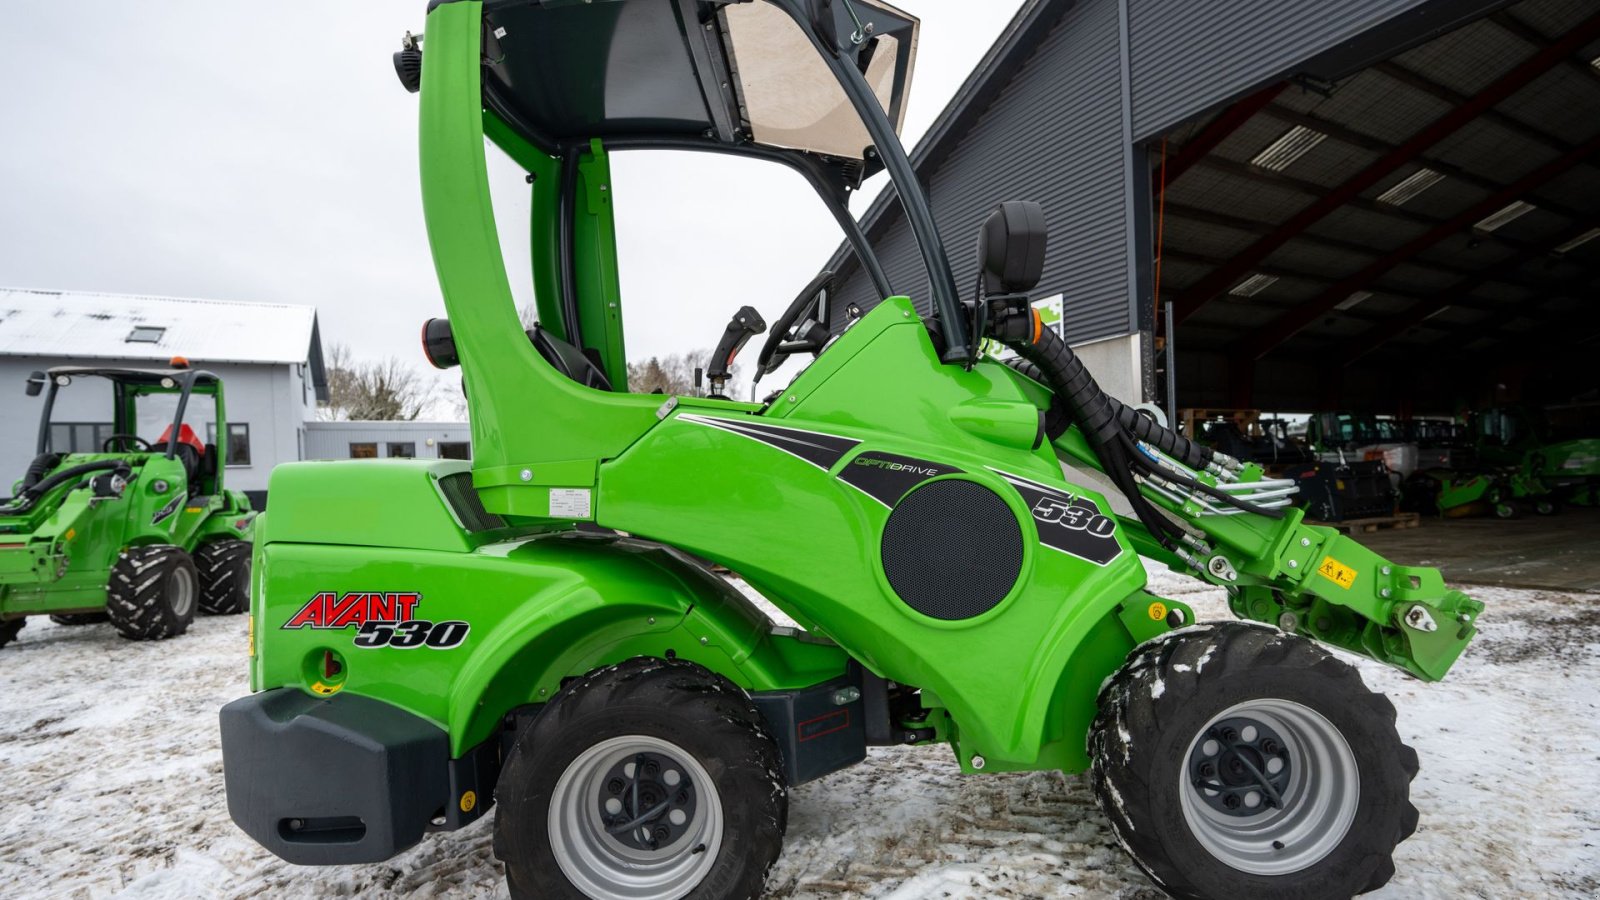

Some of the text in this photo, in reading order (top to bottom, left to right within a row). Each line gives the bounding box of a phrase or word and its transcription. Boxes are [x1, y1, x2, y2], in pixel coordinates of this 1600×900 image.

[854, 457, 938, 476] OPTIDRIVE
[1032, 496, 1117, 538] 530
[281, 591, 420, 629] AVANT
[353, 620, 471, 649] 530
